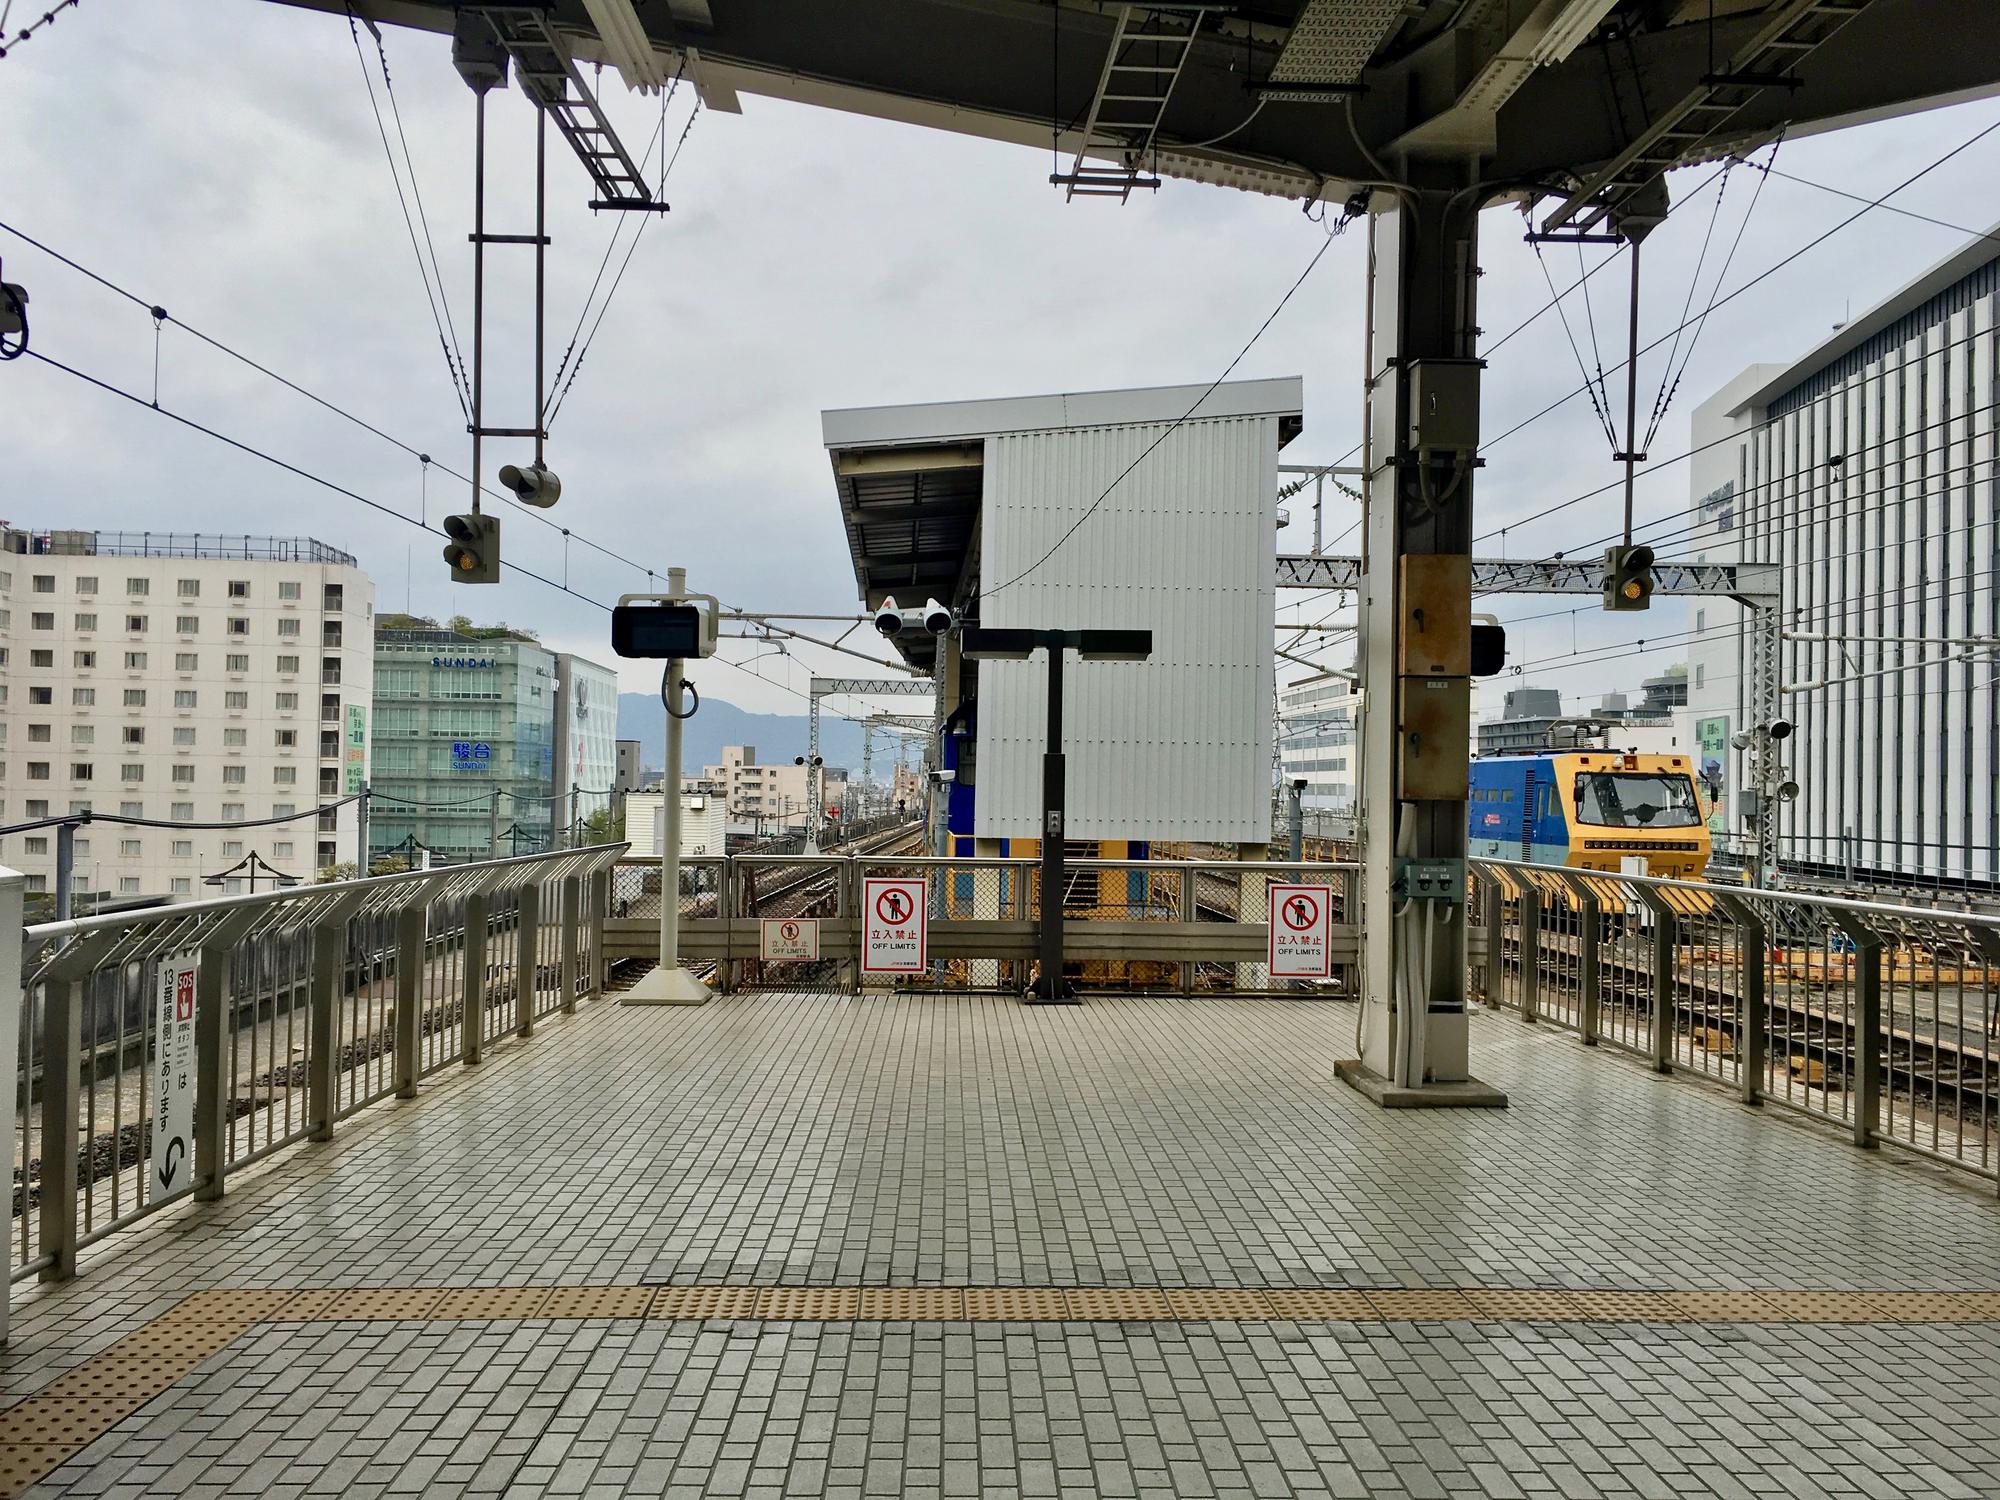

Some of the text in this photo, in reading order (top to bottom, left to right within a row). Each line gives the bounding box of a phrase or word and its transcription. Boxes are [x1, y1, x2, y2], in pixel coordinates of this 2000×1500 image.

[432, 657, 496, 668] SUNDAI
[453, 741, 491, 759] 駿台
[871, 929, 918, 940] 立入禁止
[1277, 935, 1322, 945] 立入禁止
[178, 974, 193, 990] SOS
[178, 1071, 187, 1090] は
